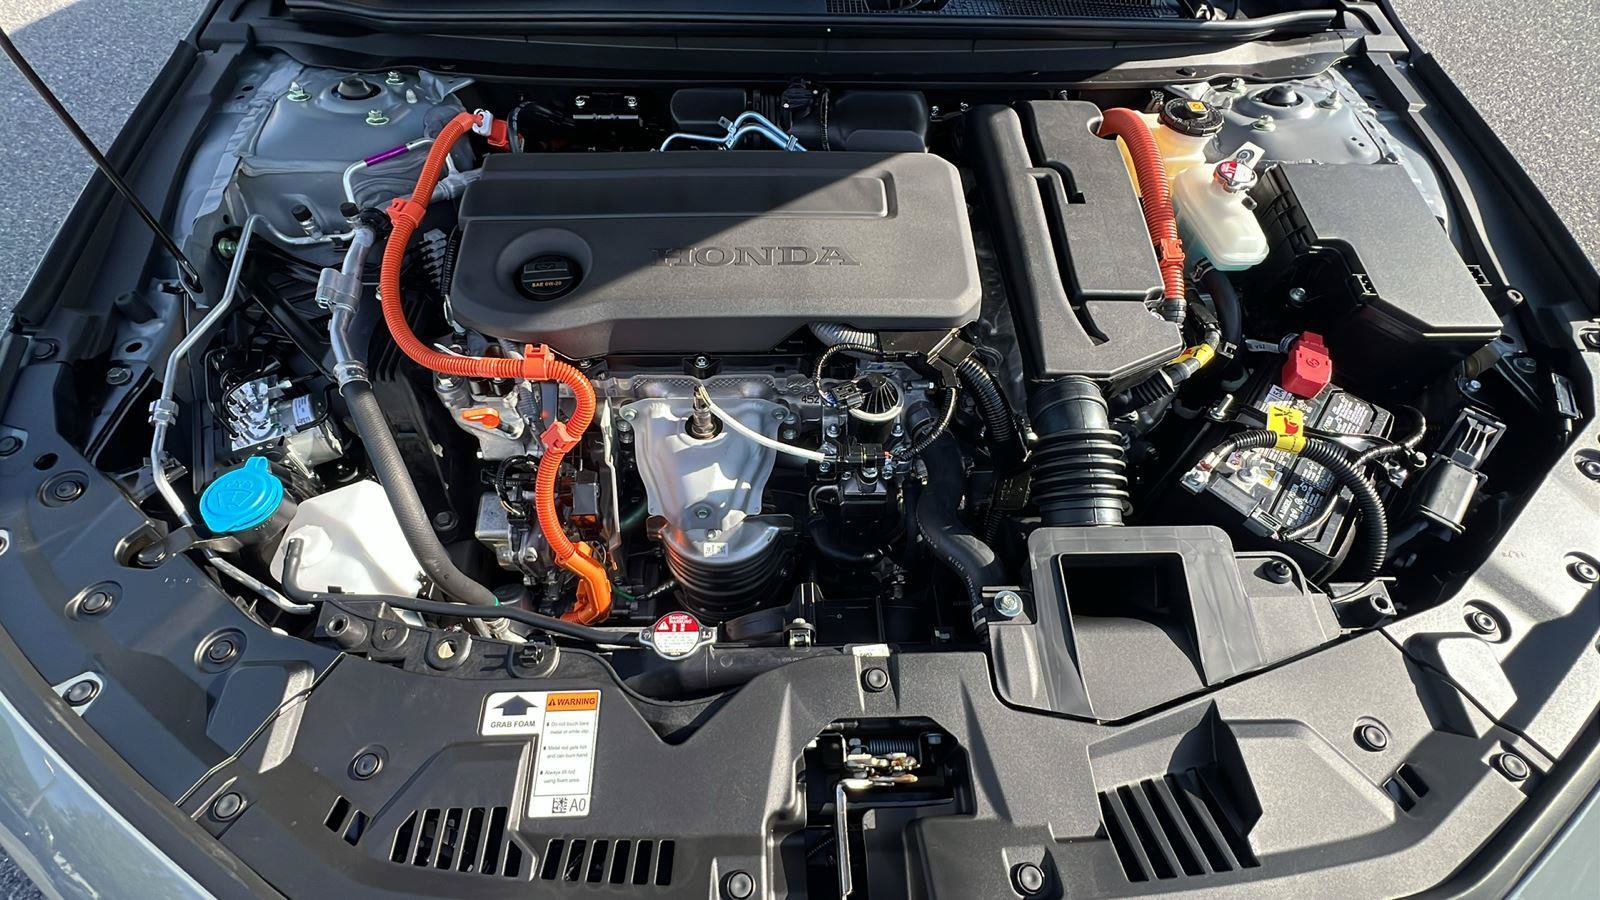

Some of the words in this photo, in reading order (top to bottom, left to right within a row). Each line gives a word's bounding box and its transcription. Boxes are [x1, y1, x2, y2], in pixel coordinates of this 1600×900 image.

[651, 247, 862, 267] HONDA
[801, 395, 820, 404] 452
[557, 697, 596, 706] WARNING
[490, 721, 513, 729] GRAB
[513, 720, 536, 728] FOAM
[569, 797, 587, 812] A0
